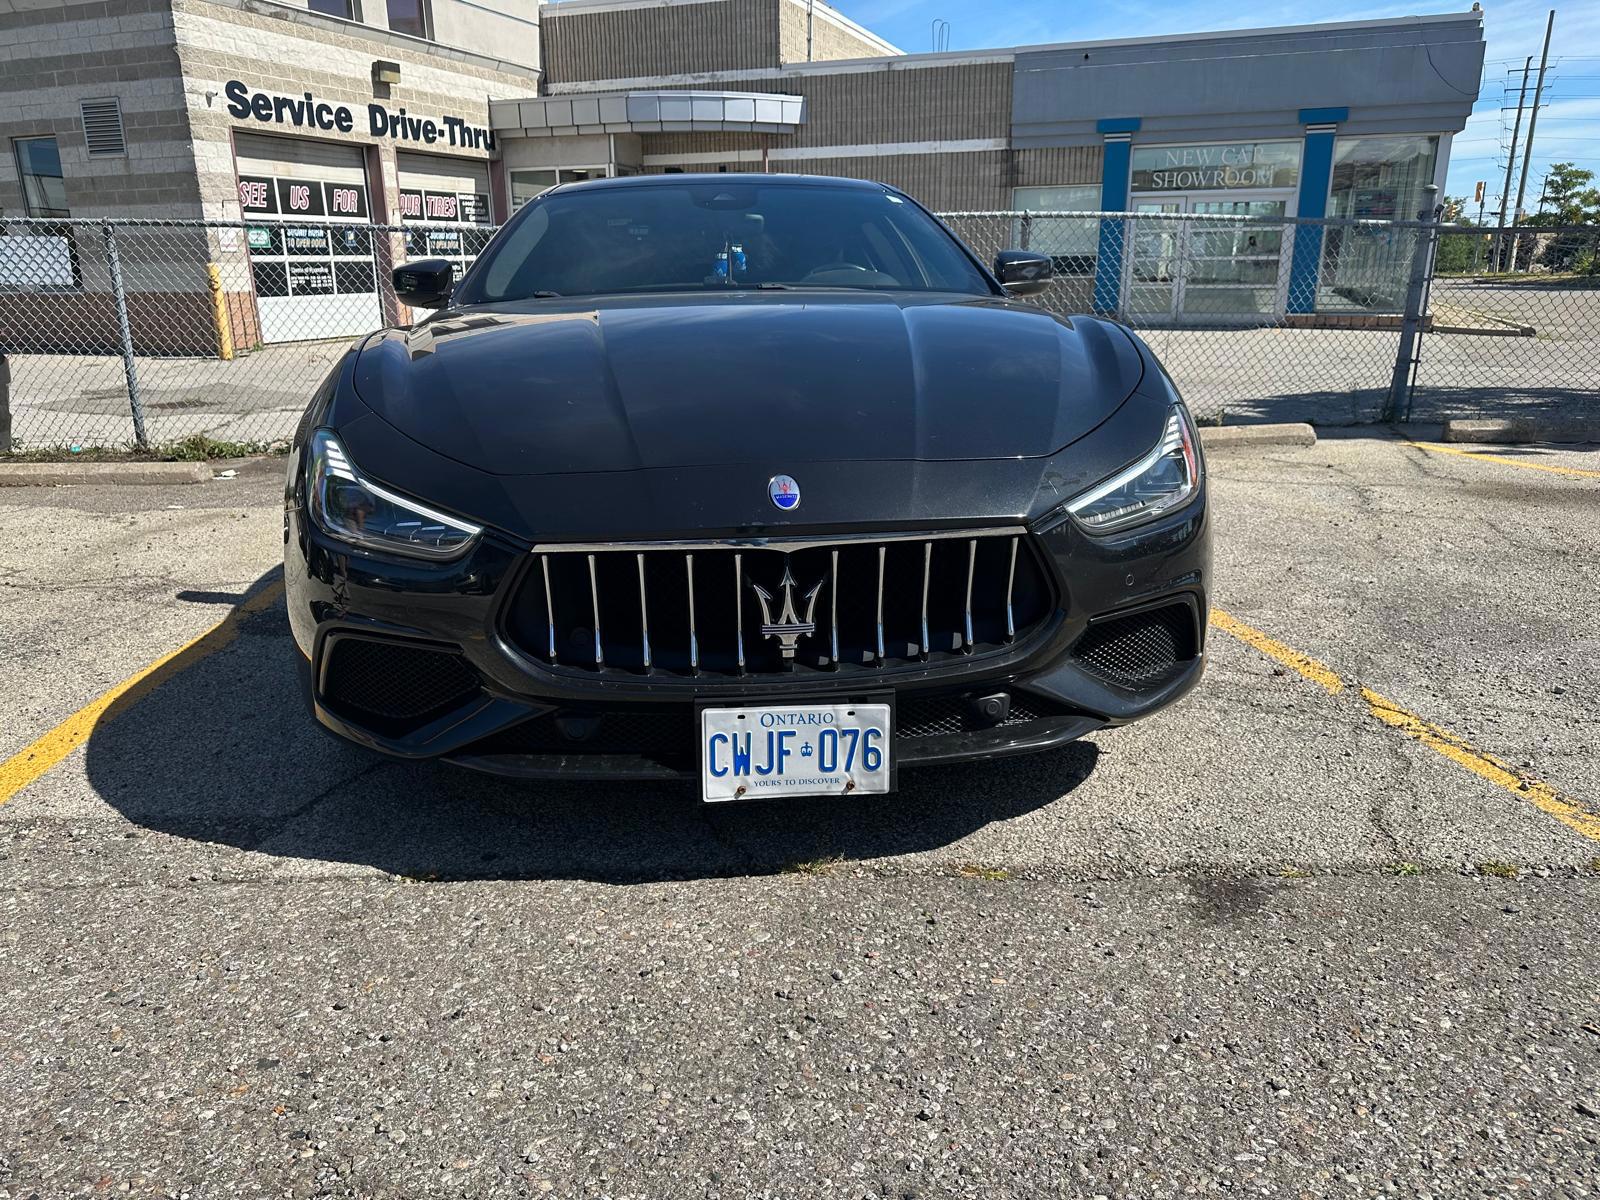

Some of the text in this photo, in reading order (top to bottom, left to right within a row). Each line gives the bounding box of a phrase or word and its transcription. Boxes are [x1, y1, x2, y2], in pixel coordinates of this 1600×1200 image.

[225, 80, 496, 151] Service Drive-Thru
[1166, 147, 1266, 166] NEW CAR
[1152, 165, 1275, 188] SHOWROOM
[239, 181, 358, 213] SEE US FOR
[426, 195, 456, 218] TIRES
[760, 712, 834, 727] ONTARIO
[709, 727, 883, 778] CWJF 076
[754, 777, 840, 787] YOURS TO DISCOVER
